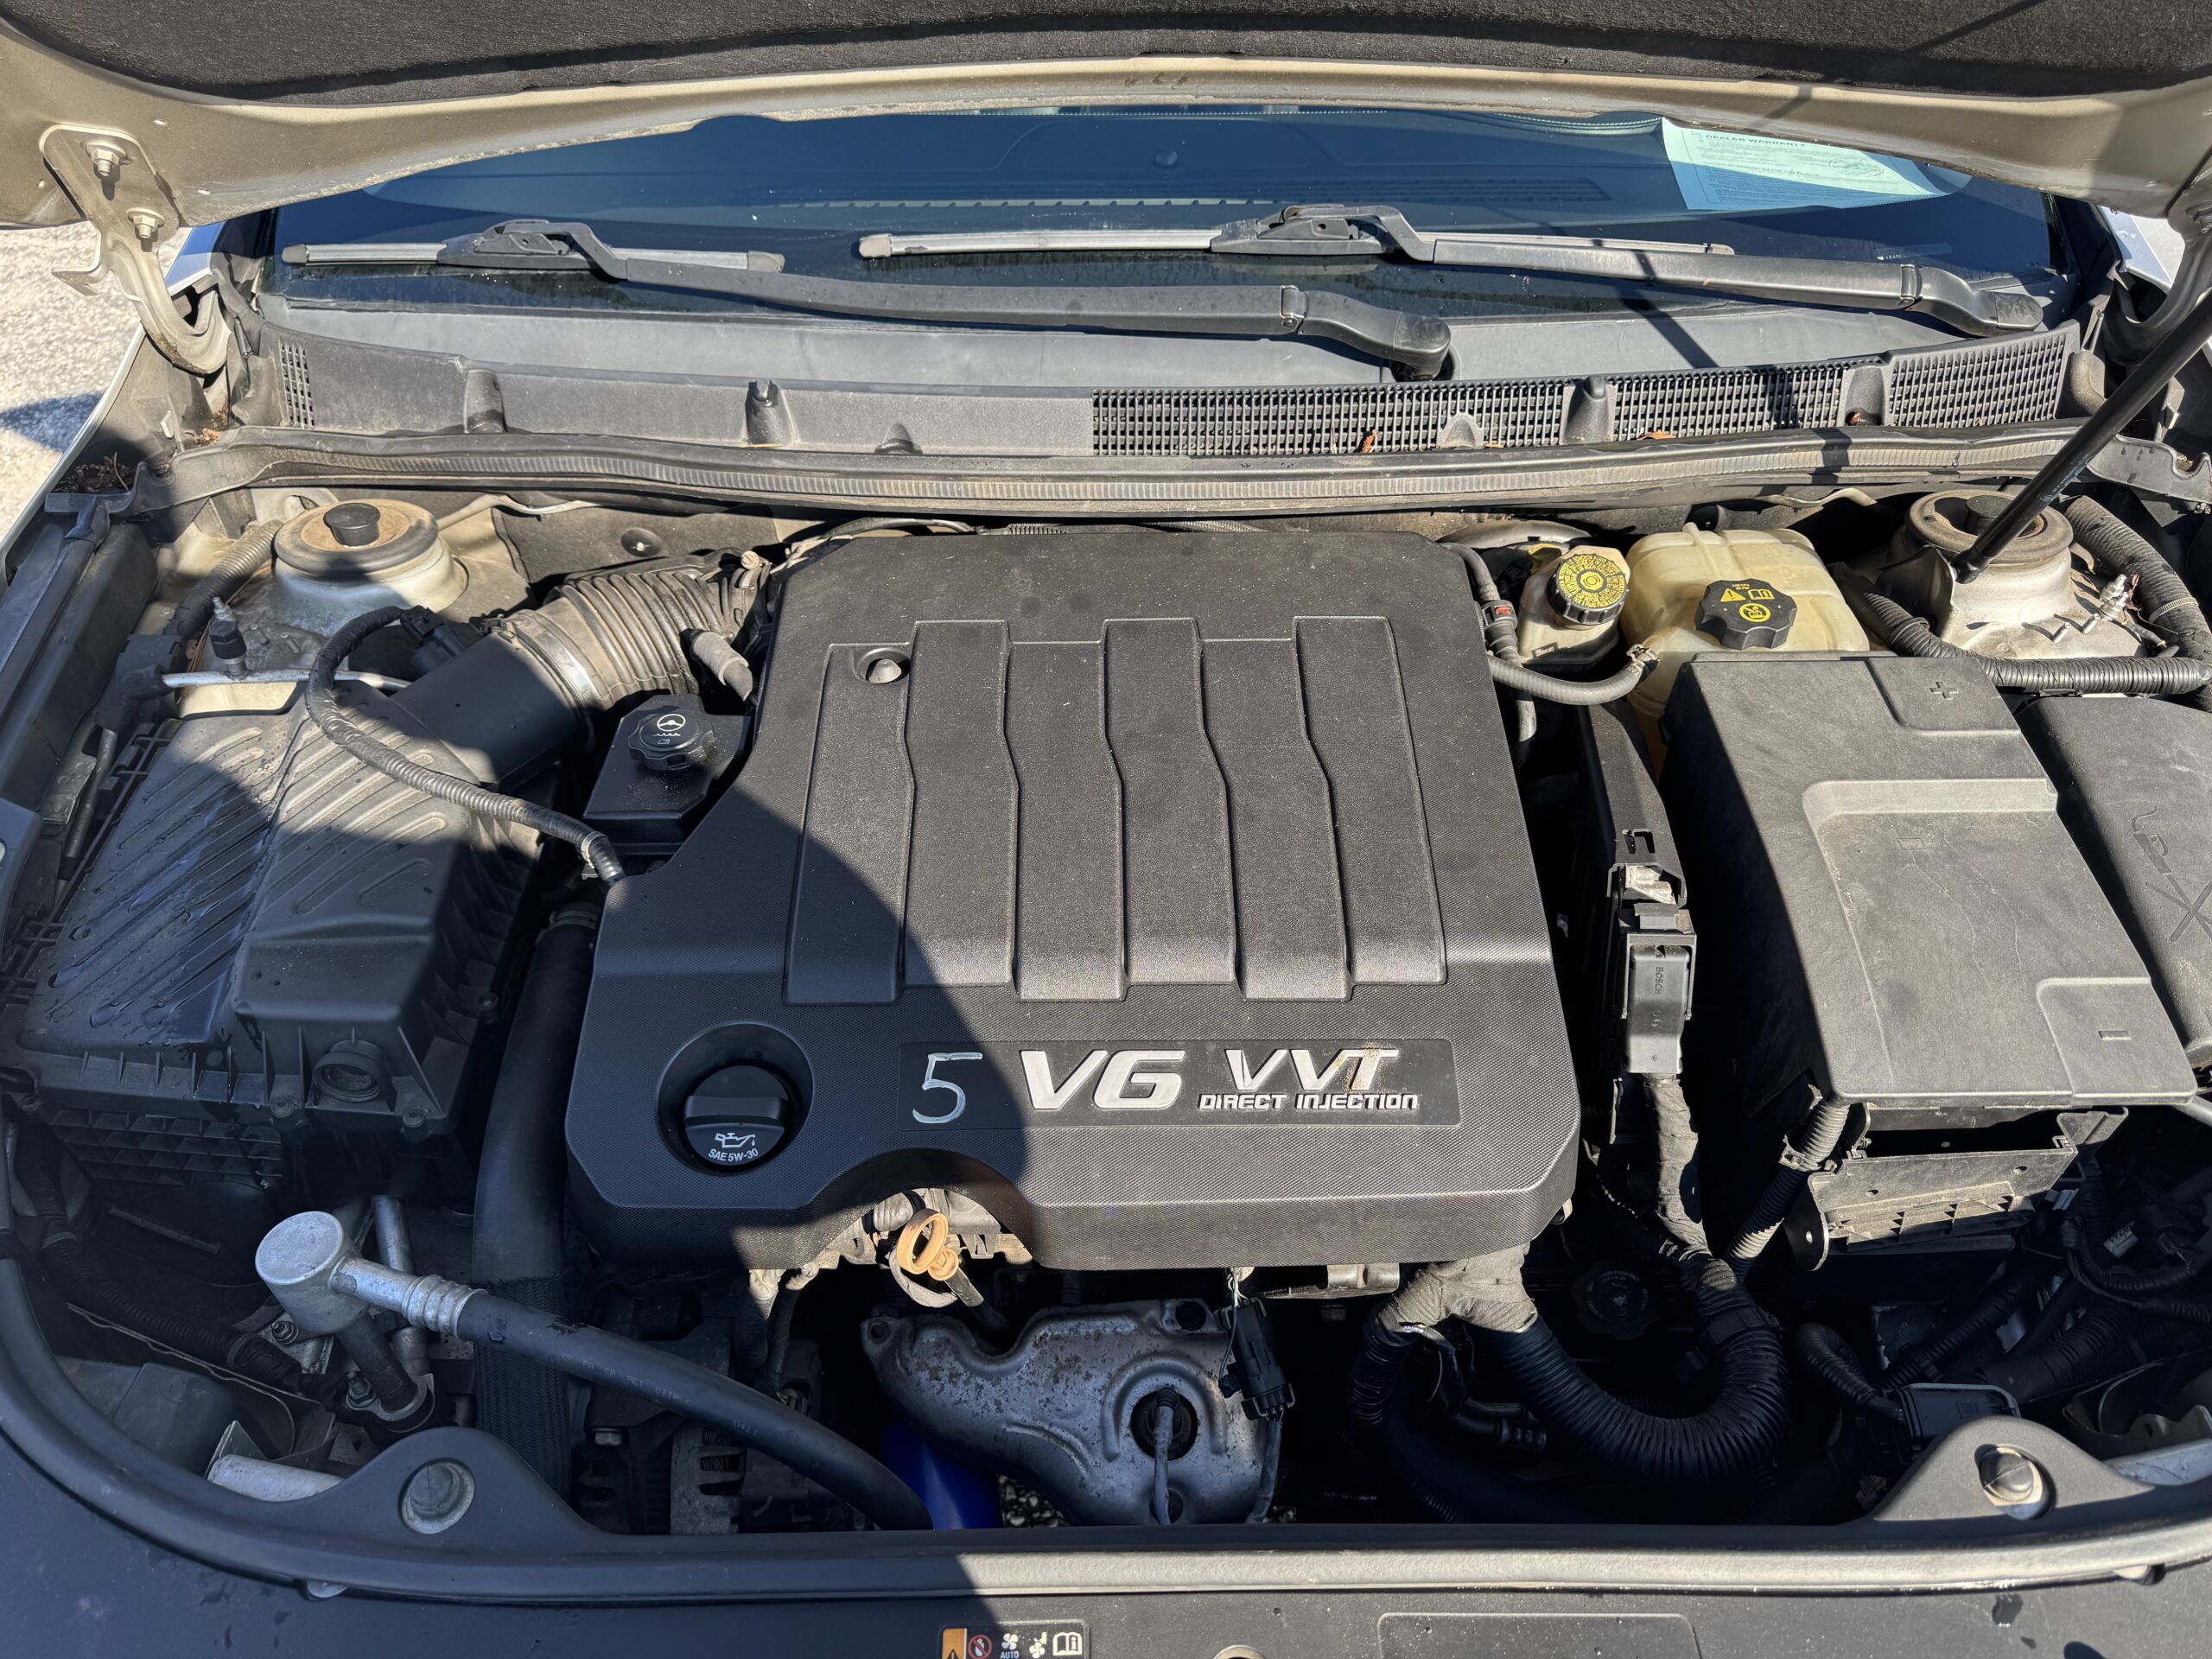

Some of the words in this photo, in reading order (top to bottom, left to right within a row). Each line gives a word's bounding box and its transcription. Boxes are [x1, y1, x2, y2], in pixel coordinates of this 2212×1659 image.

[1747, 138, 1806, 148] WARRANTY
[1654, 966, 1664, 995] BOSCH
[912, 1051, 983, 1125] 5
[1019, 1049, 1186, 1111] V6
[1224, 1048, 1400, 1091] VVT
[1198, 1093, 1287, 1112] DIRECT
[1294, 1093, 1421, 1112] INJECTION
[708, 1147, 730, 1161] SAE
[728, 1147, 759, 1162] 5W-30
[1000, 1650, 1020, 1659] AUTO
